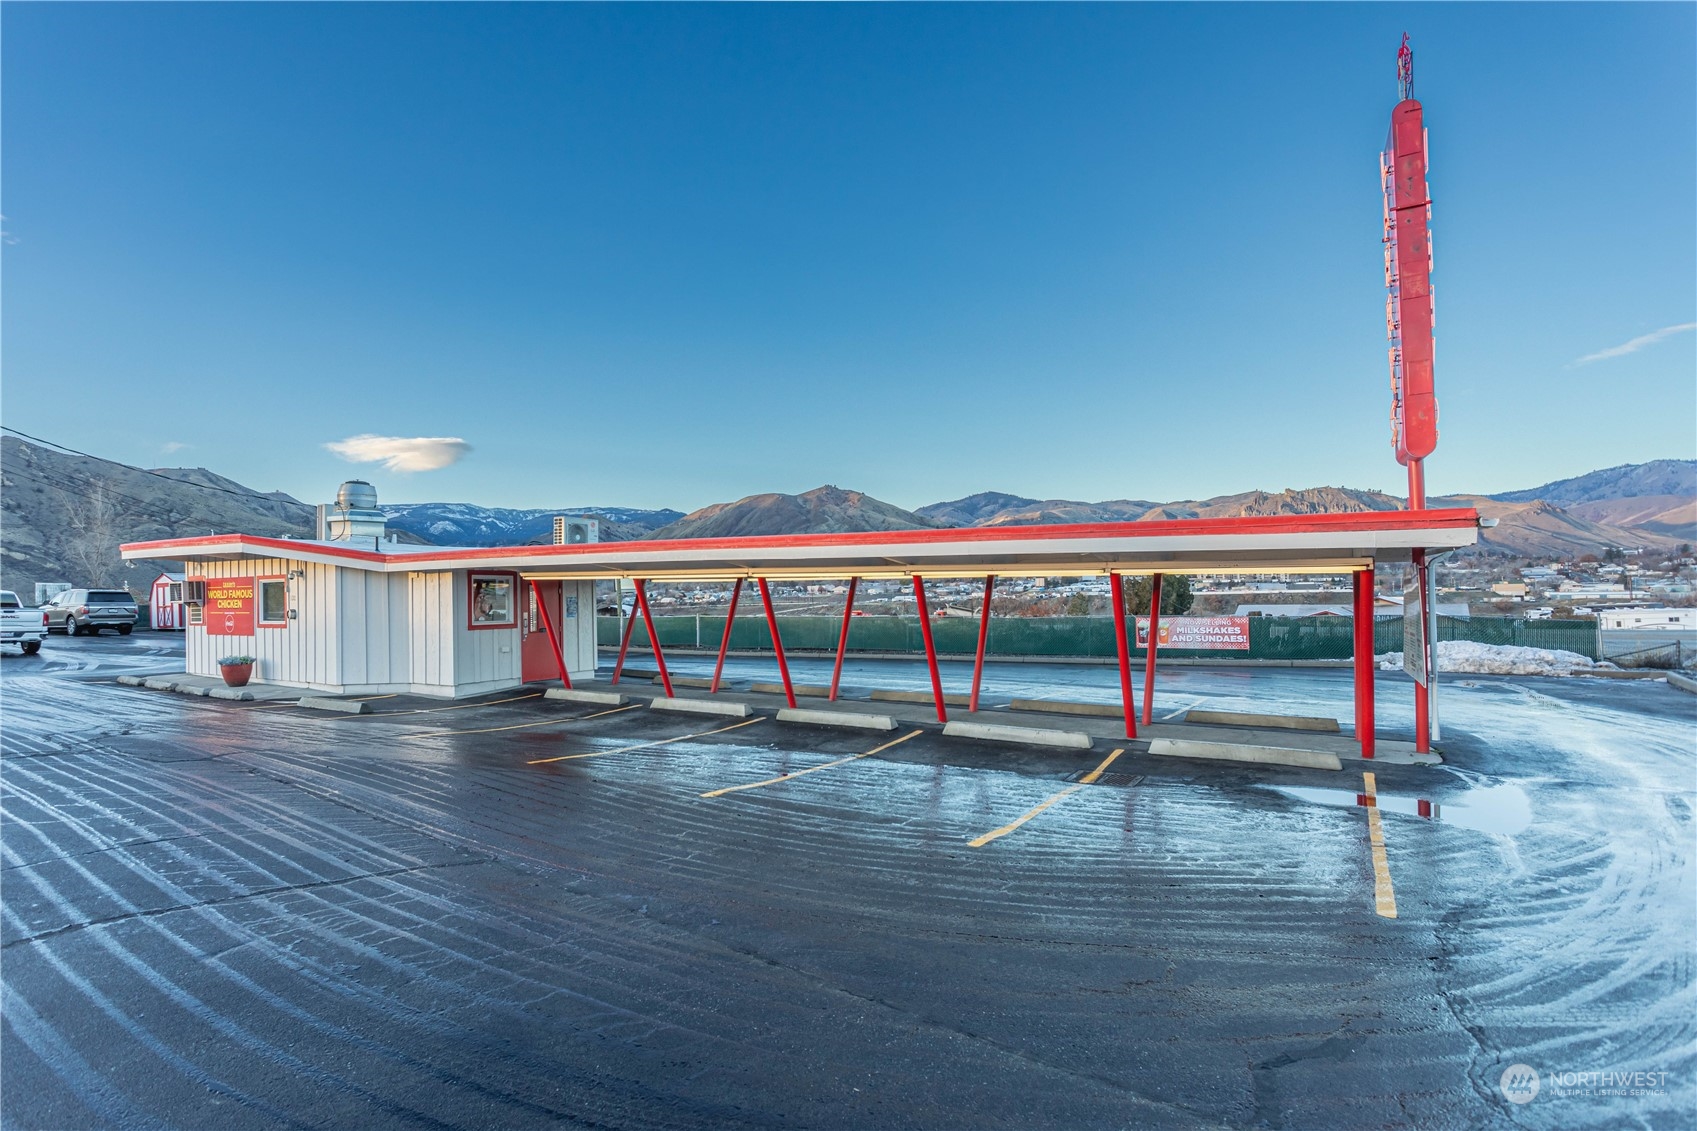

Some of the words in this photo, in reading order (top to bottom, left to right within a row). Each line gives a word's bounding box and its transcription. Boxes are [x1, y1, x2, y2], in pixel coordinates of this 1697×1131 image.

[208, 590, 227, 598] WORLD
[229, 590, 253, 598] FAMOUS
[218, 600, 242, 608] CHICKEN
[1176, 626, 1242, 634] MILKSHAKES
